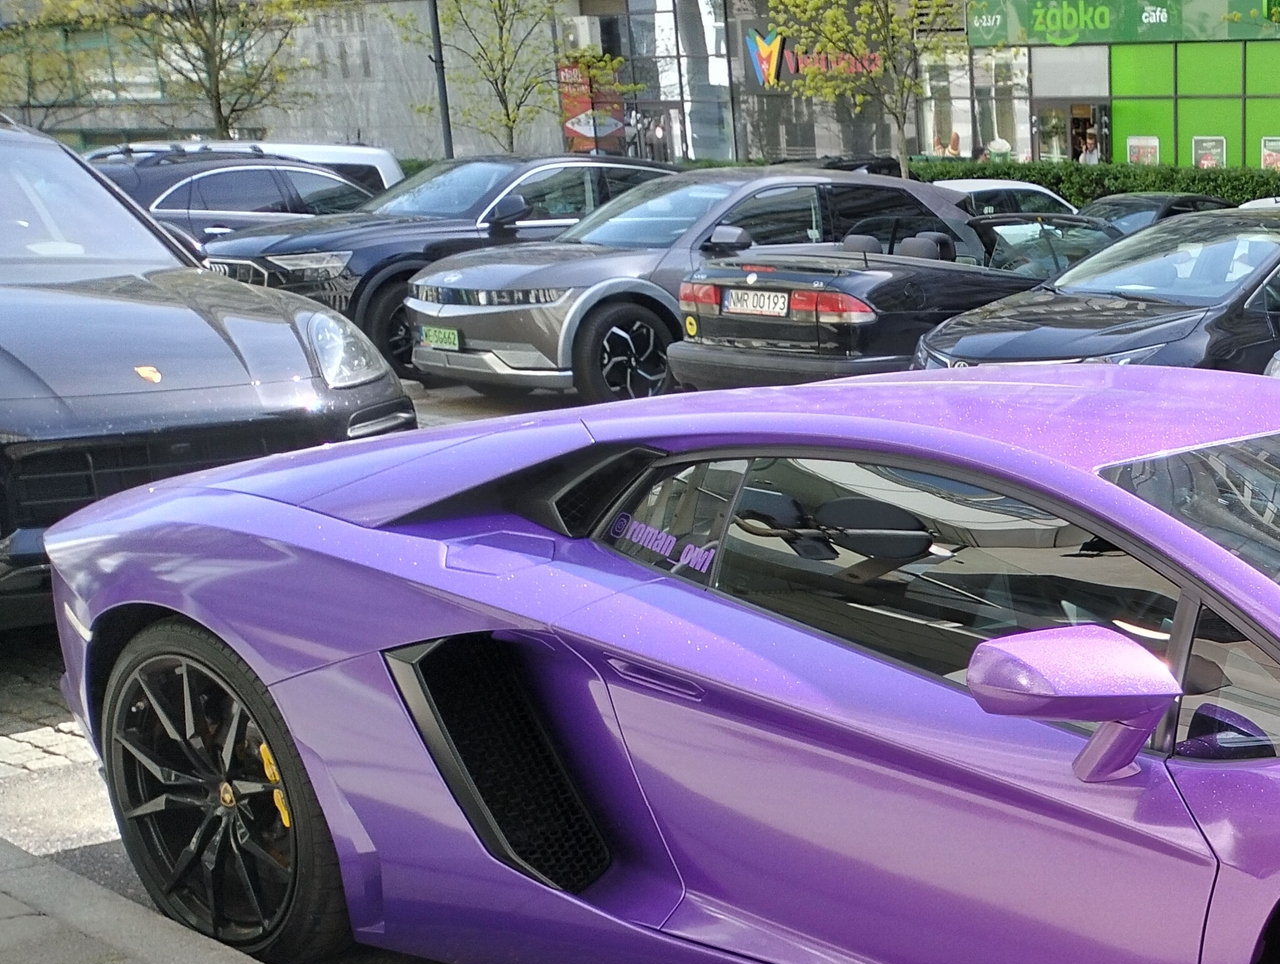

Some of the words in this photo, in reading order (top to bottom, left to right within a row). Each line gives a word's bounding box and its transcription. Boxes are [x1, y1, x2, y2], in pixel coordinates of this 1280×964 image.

[1033, 1, 1110, 31] żabka
[729, 291, 749, 308] NMR
[752, 293, 786, 310] 00193
